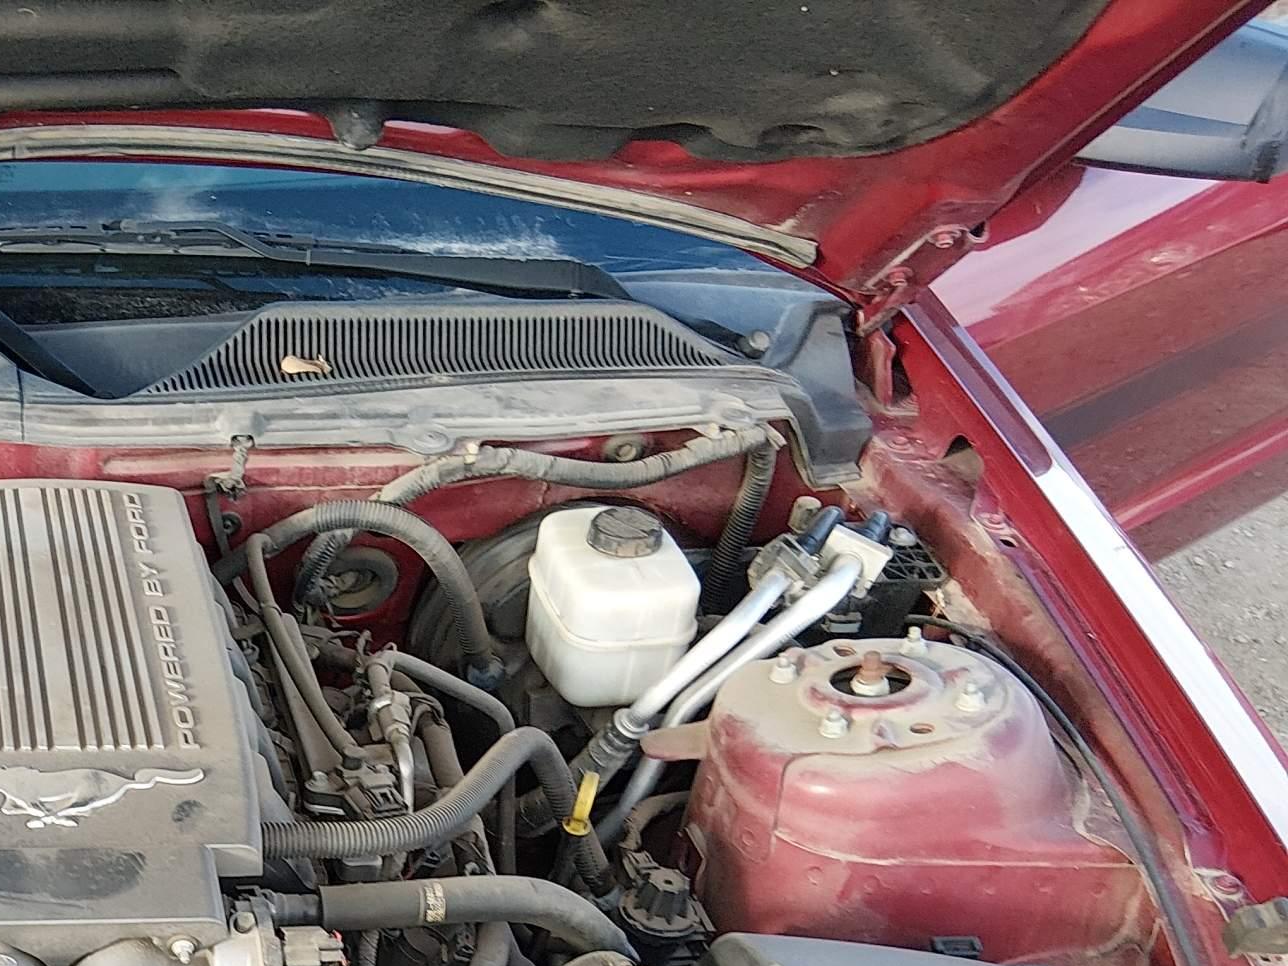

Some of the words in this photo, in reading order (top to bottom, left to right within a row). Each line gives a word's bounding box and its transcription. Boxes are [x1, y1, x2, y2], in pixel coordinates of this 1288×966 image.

[122, 492, 154, 553] FORD
[143, 560, 165, 597] BY
[151, 605, 202, 750] POWERED
